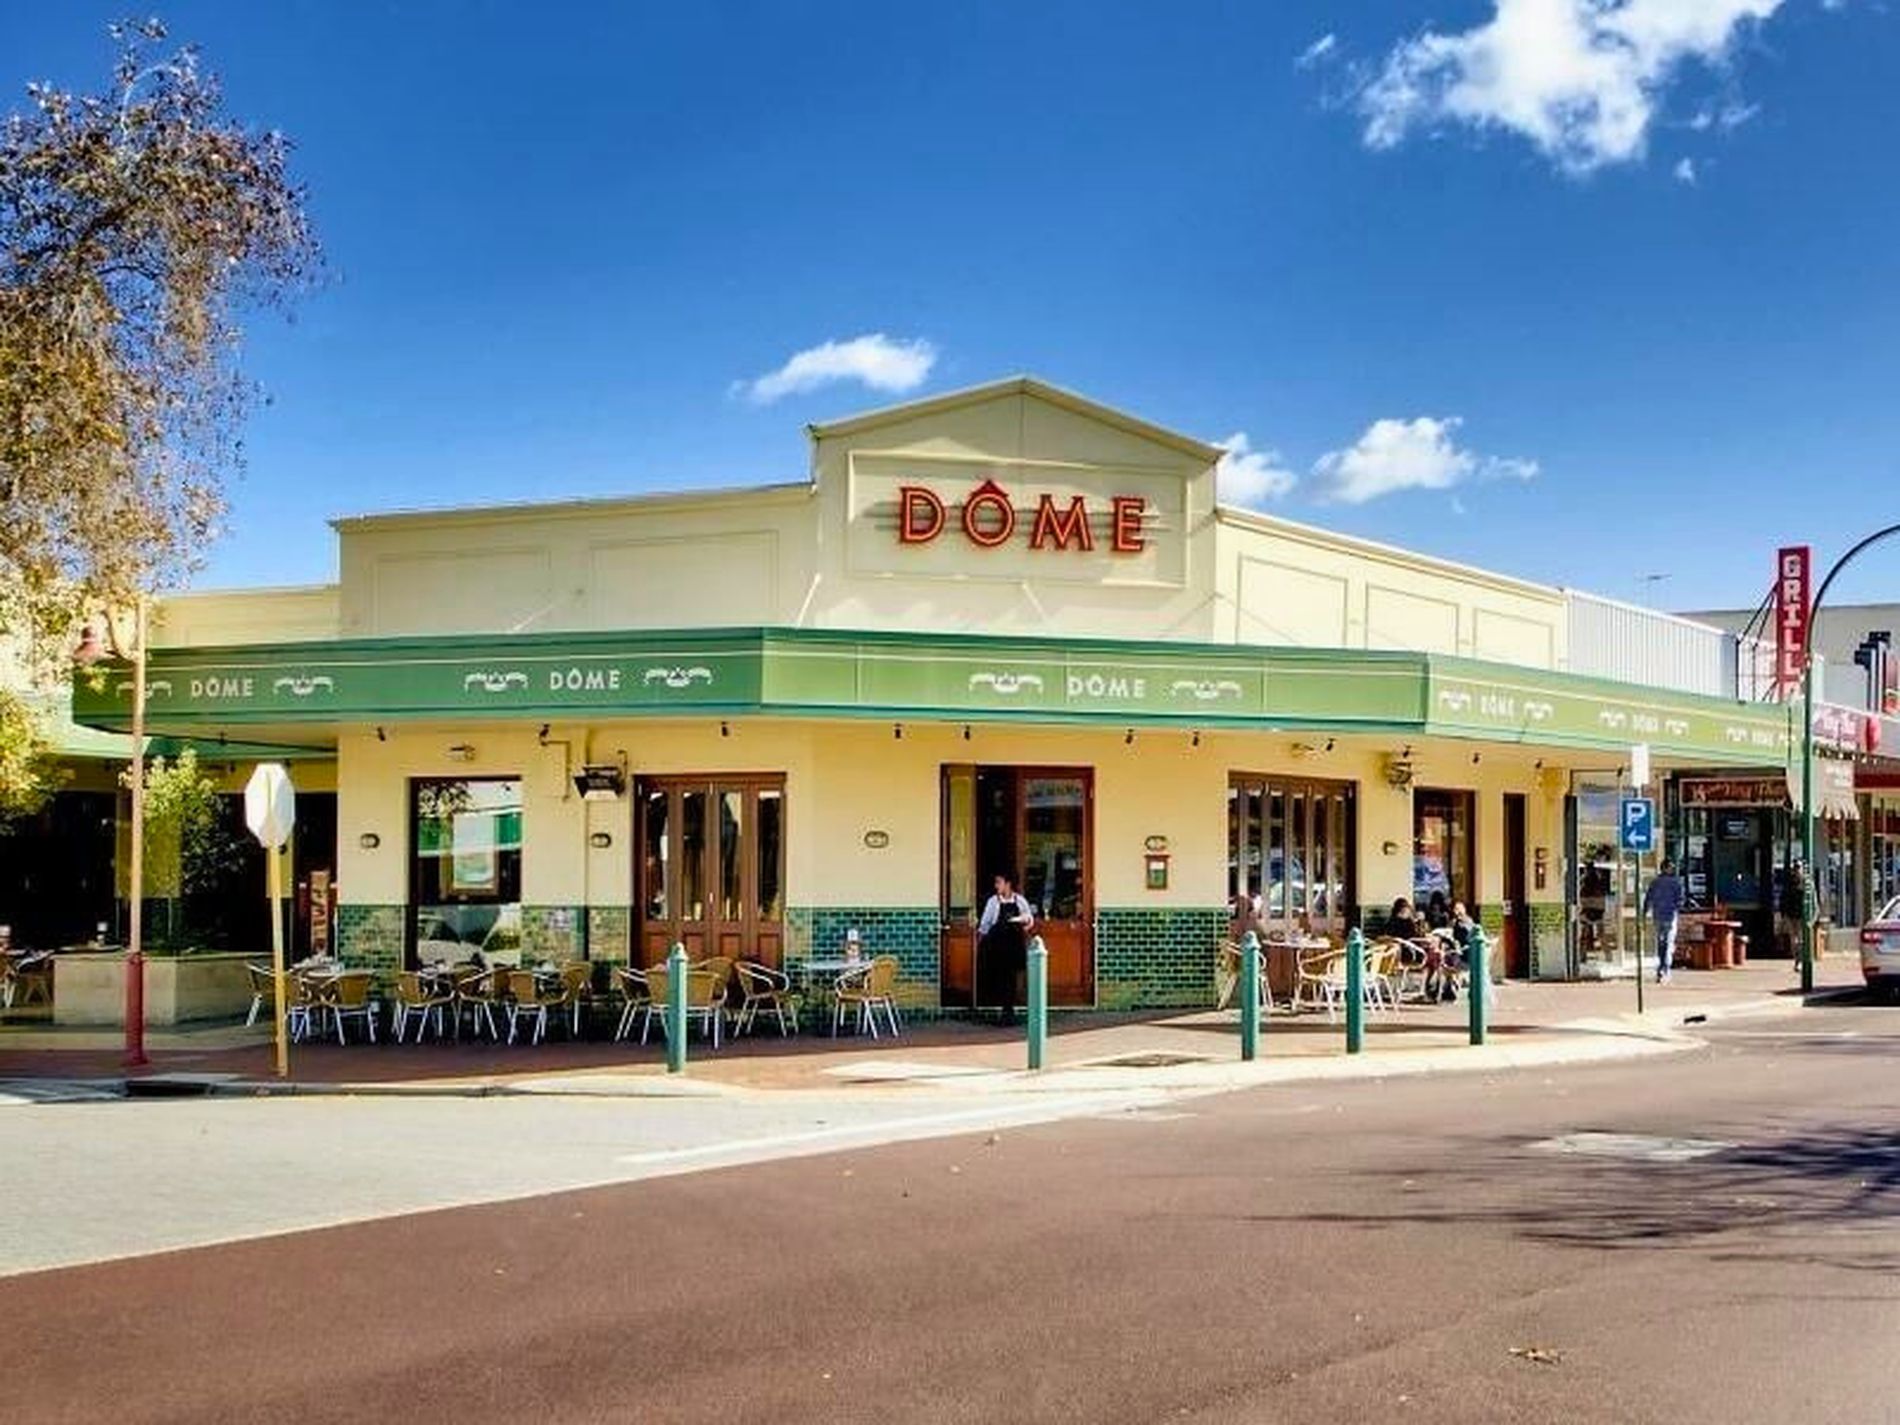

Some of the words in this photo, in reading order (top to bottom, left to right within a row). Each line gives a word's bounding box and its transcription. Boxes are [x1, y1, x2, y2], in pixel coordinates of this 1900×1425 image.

[899, 478, 1146, 552] DÔME
[191, 676, 253, 698] DÔME
[550, 667, 621, 690] DÔME
[1066, 674, 1145, 699] DÔME
[1626, 802, 1647, 827] P
